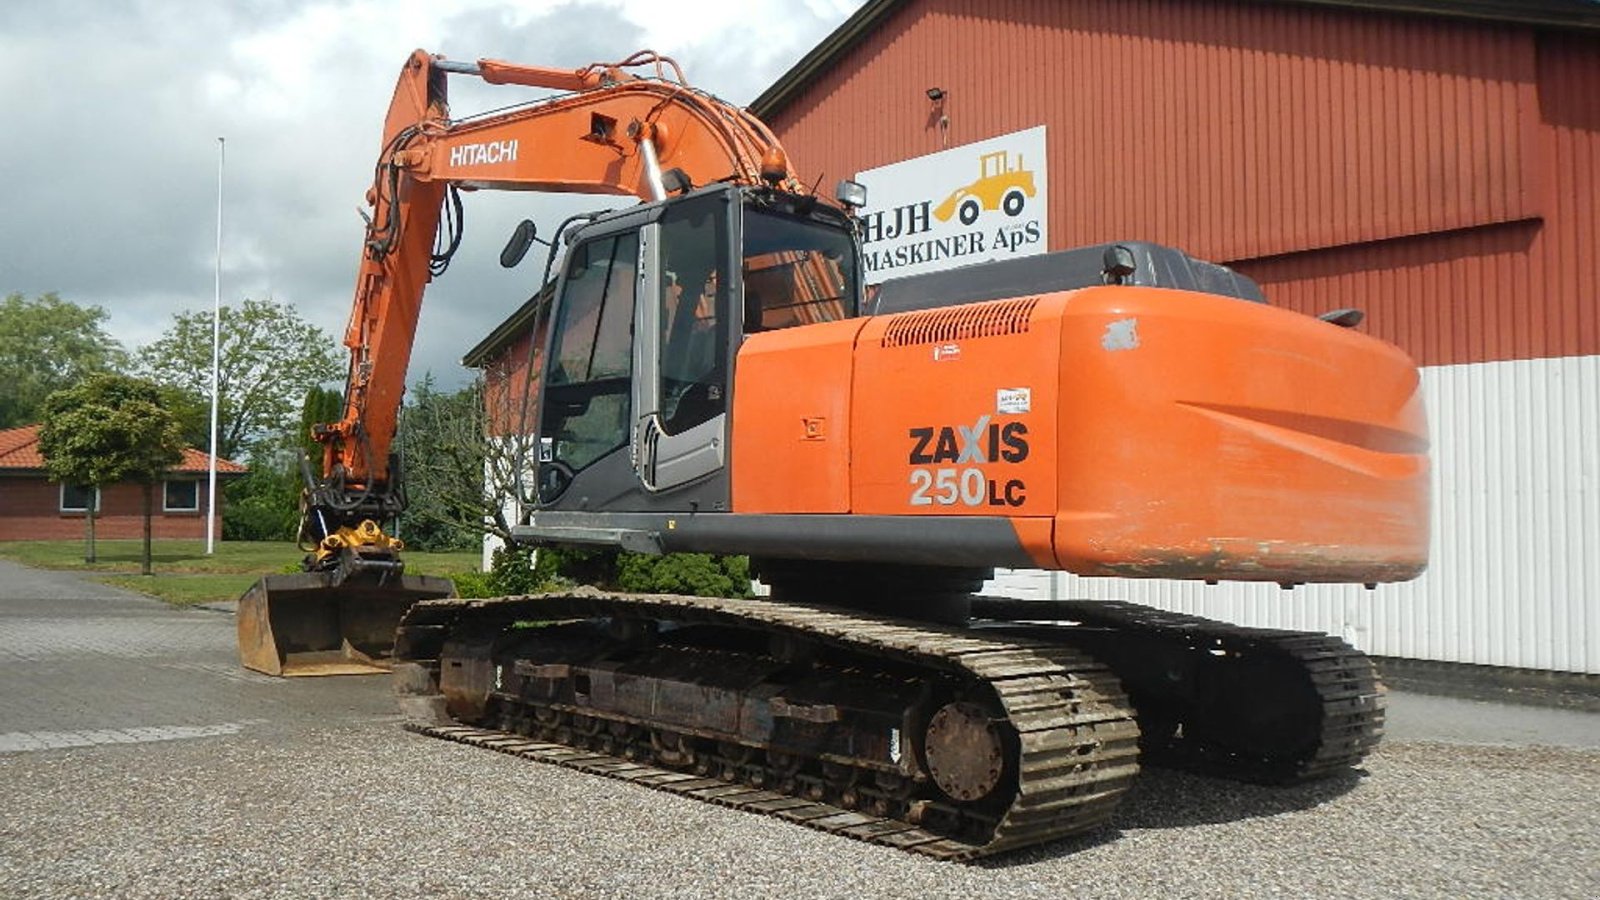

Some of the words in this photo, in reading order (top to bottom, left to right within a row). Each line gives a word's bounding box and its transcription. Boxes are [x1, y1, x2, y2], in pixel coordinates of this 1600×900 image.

[449, 139, 519, 167] HITACHI
[863, 200, 932, 244] HJH
[864, 231, 985, 272] MASKINER
[992, 220, 1040, 252] ApS
[909, 415, 1029, 465] ZAXIS
